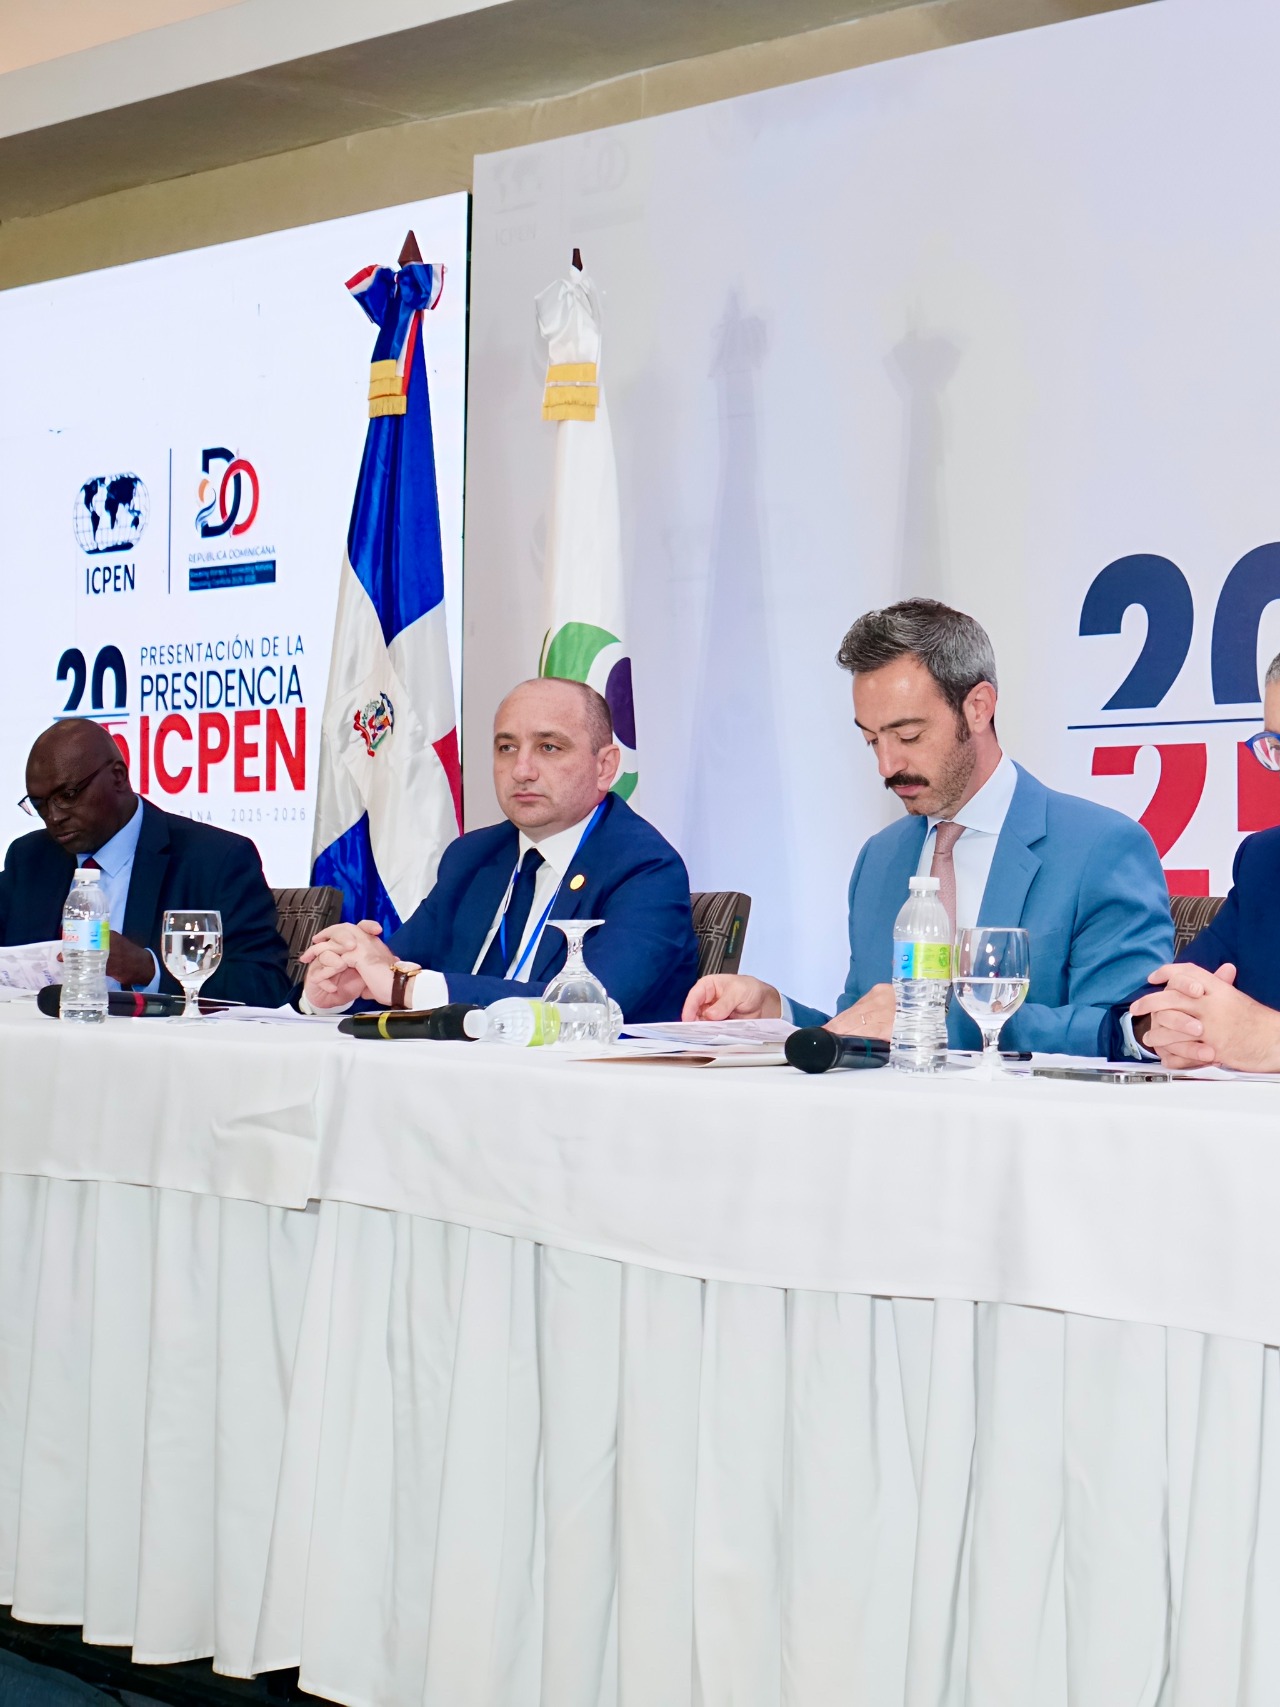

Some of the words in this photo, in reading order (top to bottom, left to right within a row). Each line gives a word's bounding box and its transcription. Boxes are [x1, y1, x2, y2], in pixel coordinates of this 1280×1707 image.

[86, 563, 136, 595] ICPEN
[140, 634, 254, 667] PRESENTACIÓN
[261, 636, 280, 658] DE
[287, 634, 305, 657] LA
[56, 644, 128, 712] 20
[140, 664, 303, 712] PRESIDENCIA
[139, 707, 306, 795] ICPEN
[231, 807, 307, 823] 2025-2026
